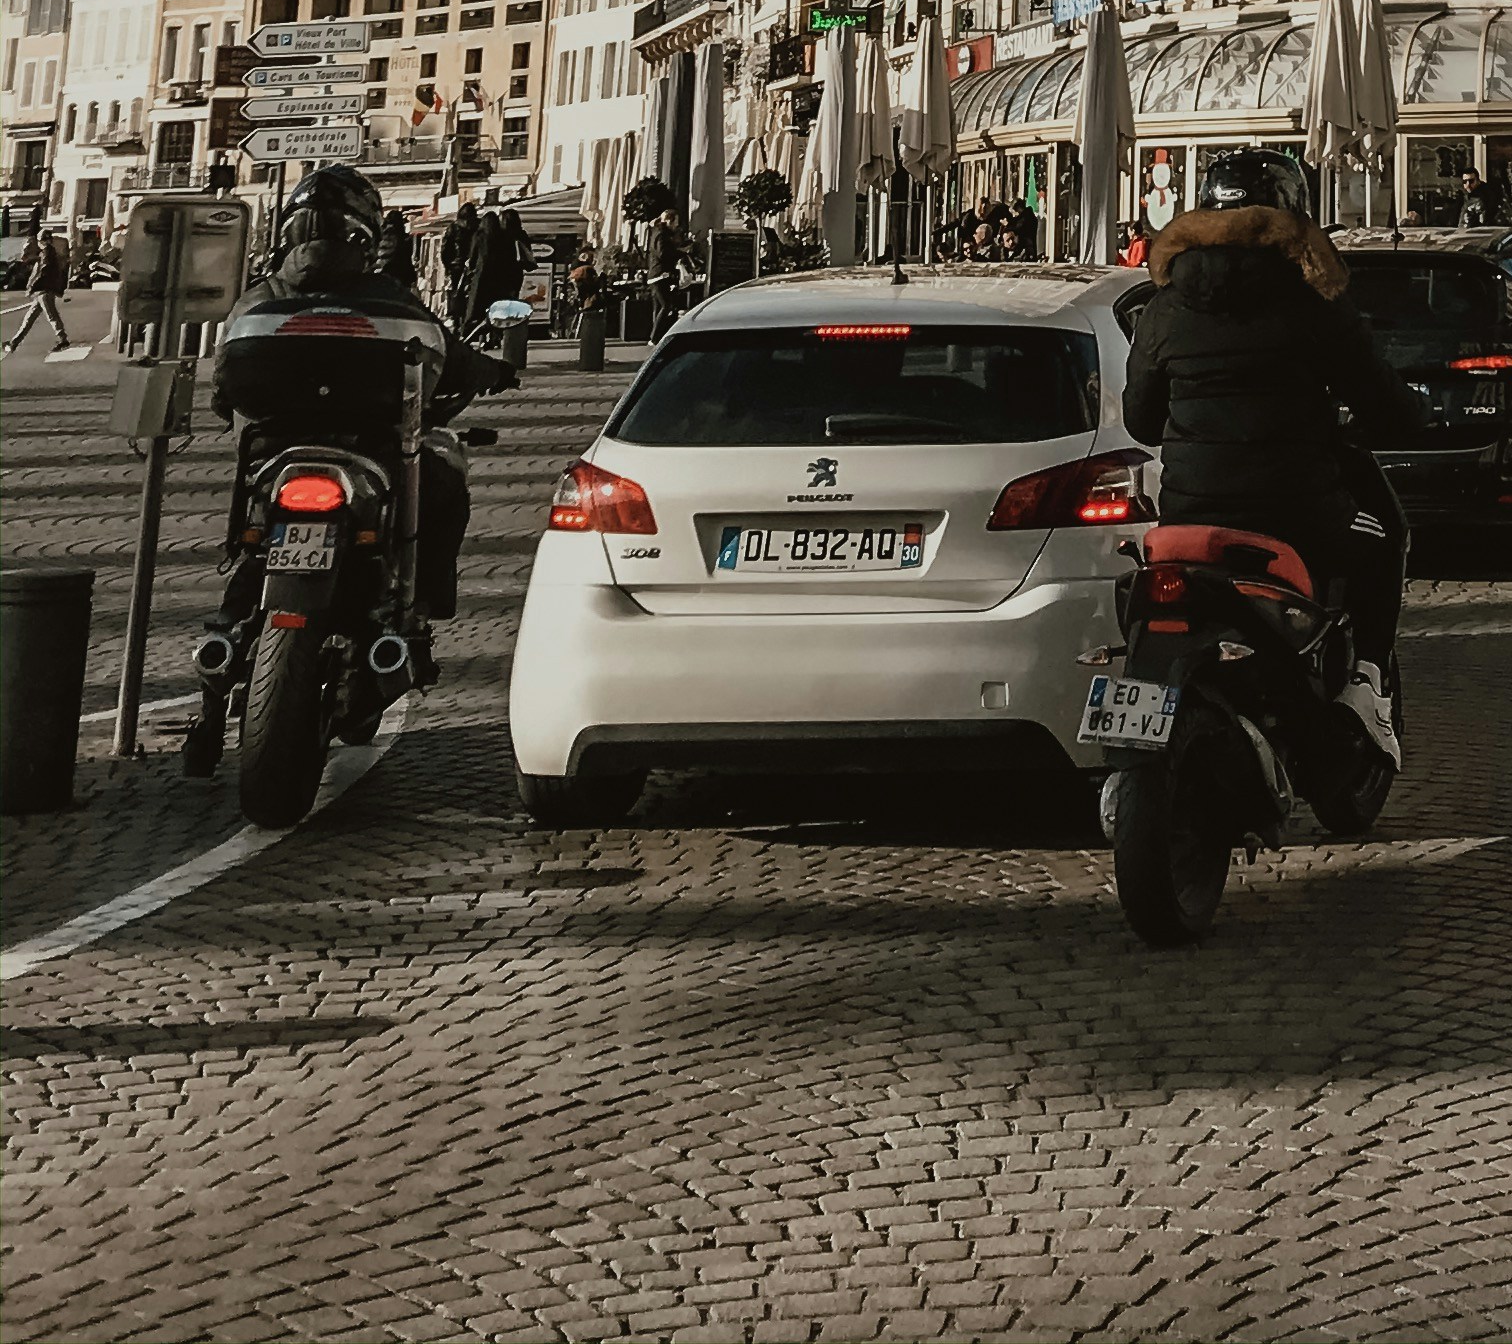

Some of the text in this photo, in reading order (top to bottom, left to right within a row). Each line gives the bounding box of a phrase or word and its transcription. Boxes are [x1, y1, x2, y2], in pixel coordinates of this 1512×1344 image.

[296, 27, 347, 38] Vieux Port
[295, 38, 361, 50] Hôtel de Ville
[270, 70, 360, 82] Cars de Tourisme
[276, 101, 334, 113] Esplanade
[286, 132, 347, 143] Cathédrale
[284, 143, 355, 155] de la Major
[1463, 406, 1496, 415] TIPO
[786, 493, 855, 503] PEUGEOT
[620, 547, 661, 559] 308
